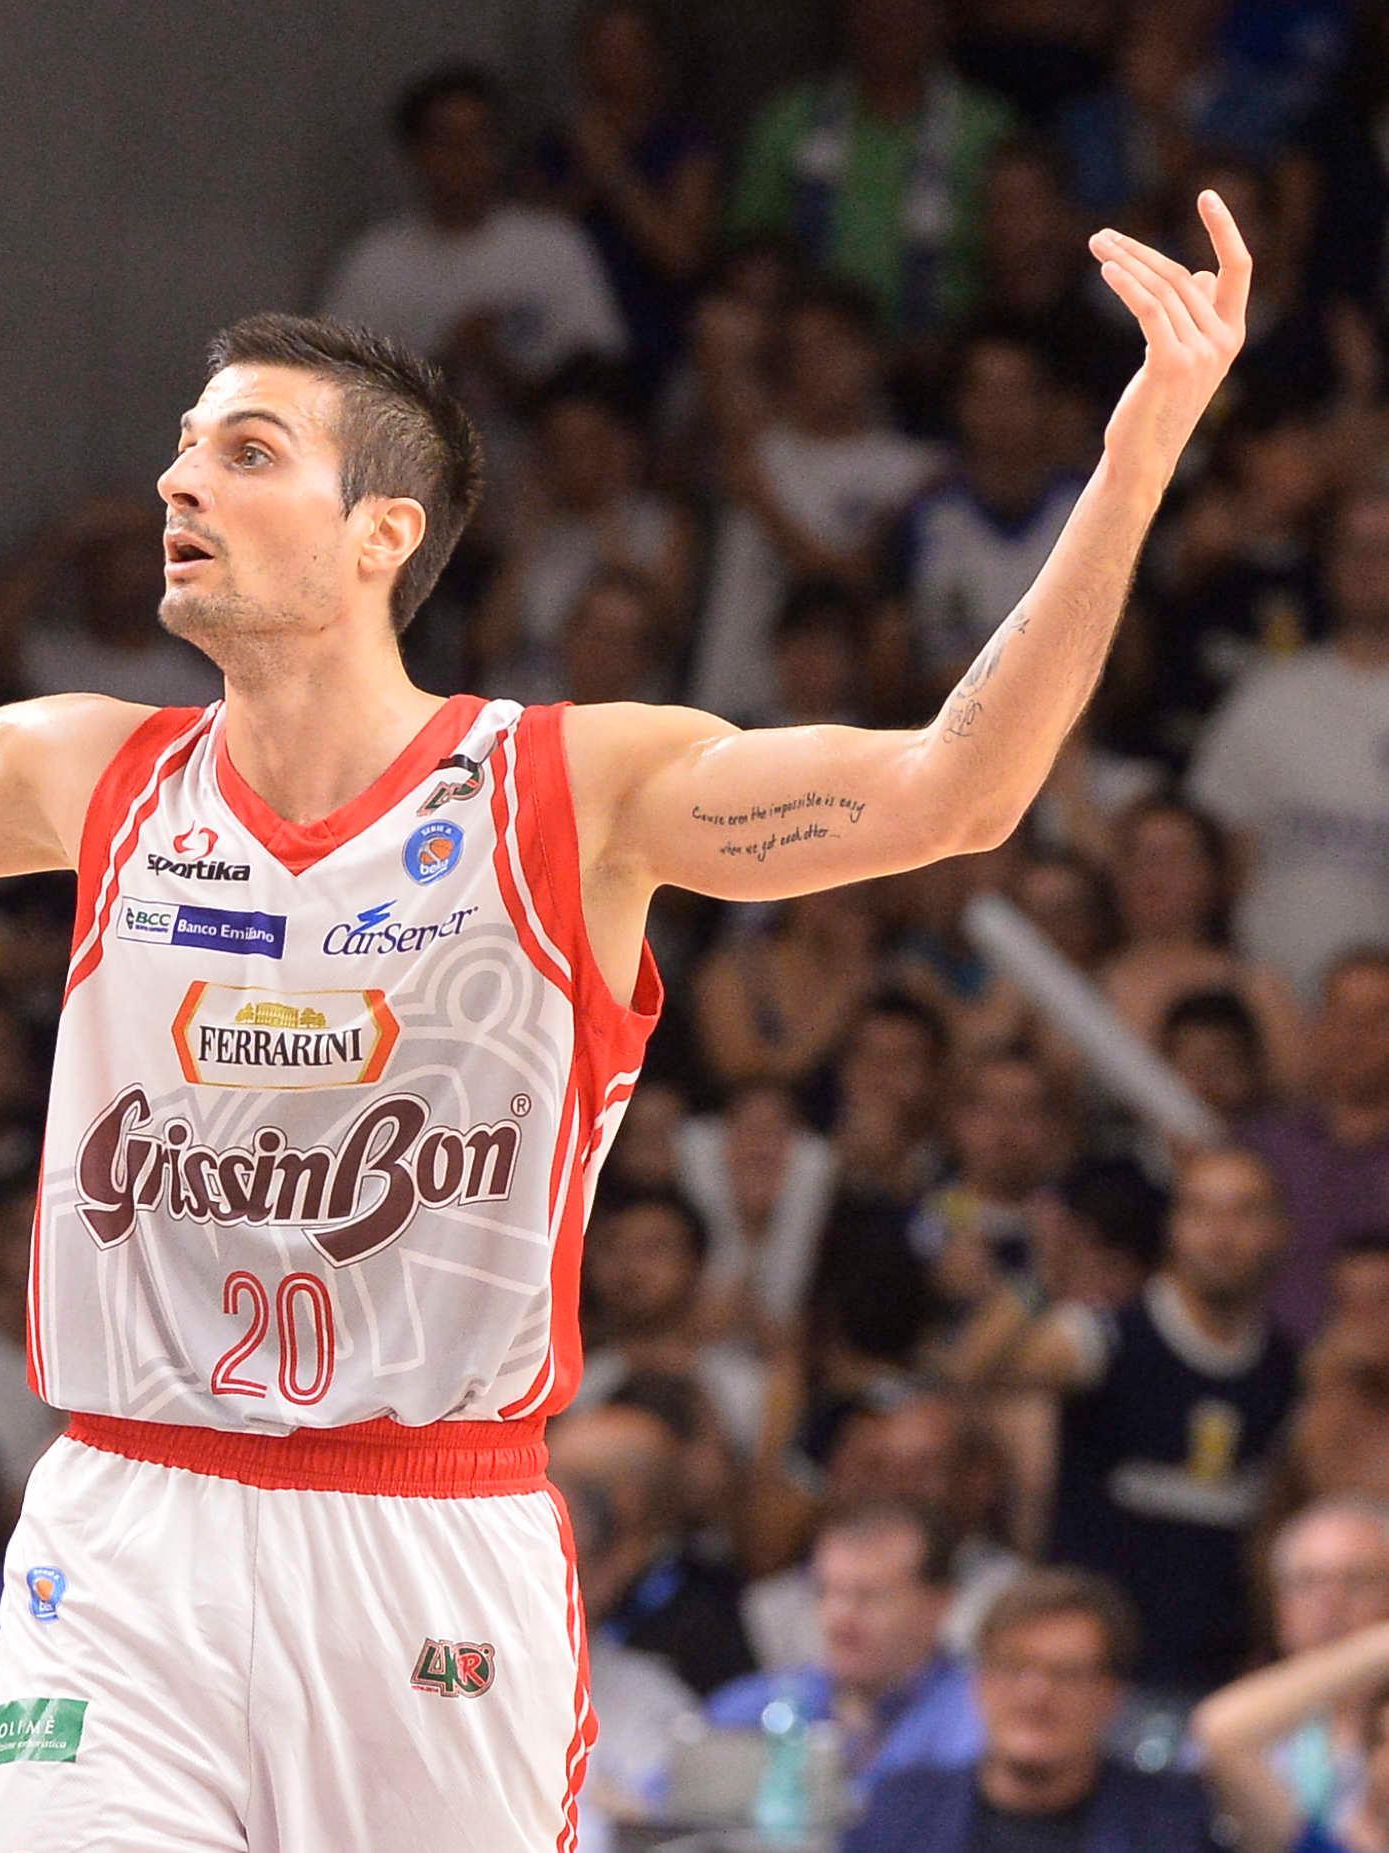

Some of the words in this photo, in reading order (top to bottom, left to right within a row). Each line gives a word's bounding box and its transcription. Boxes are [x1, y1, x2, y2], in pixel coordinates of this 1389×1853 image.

[751, 805, 767, 820] the
[769, 792, 821, 818] impossible
[824, 793, 835, 806] is
[839, 797, 866, 823] easy
[758, 833, 776, 862] got
[779, 827, 801, 845] each
[147, 853, 251, 881] sportika
[136, 911, 171, 927] BCC
[177, 919, 217, 936] Banco
[198, 1024, 363, 1067] FERRARINI
[74, 1082, 523, 1268] GrissinBon
[211, 1270, 336, 1406] 20
